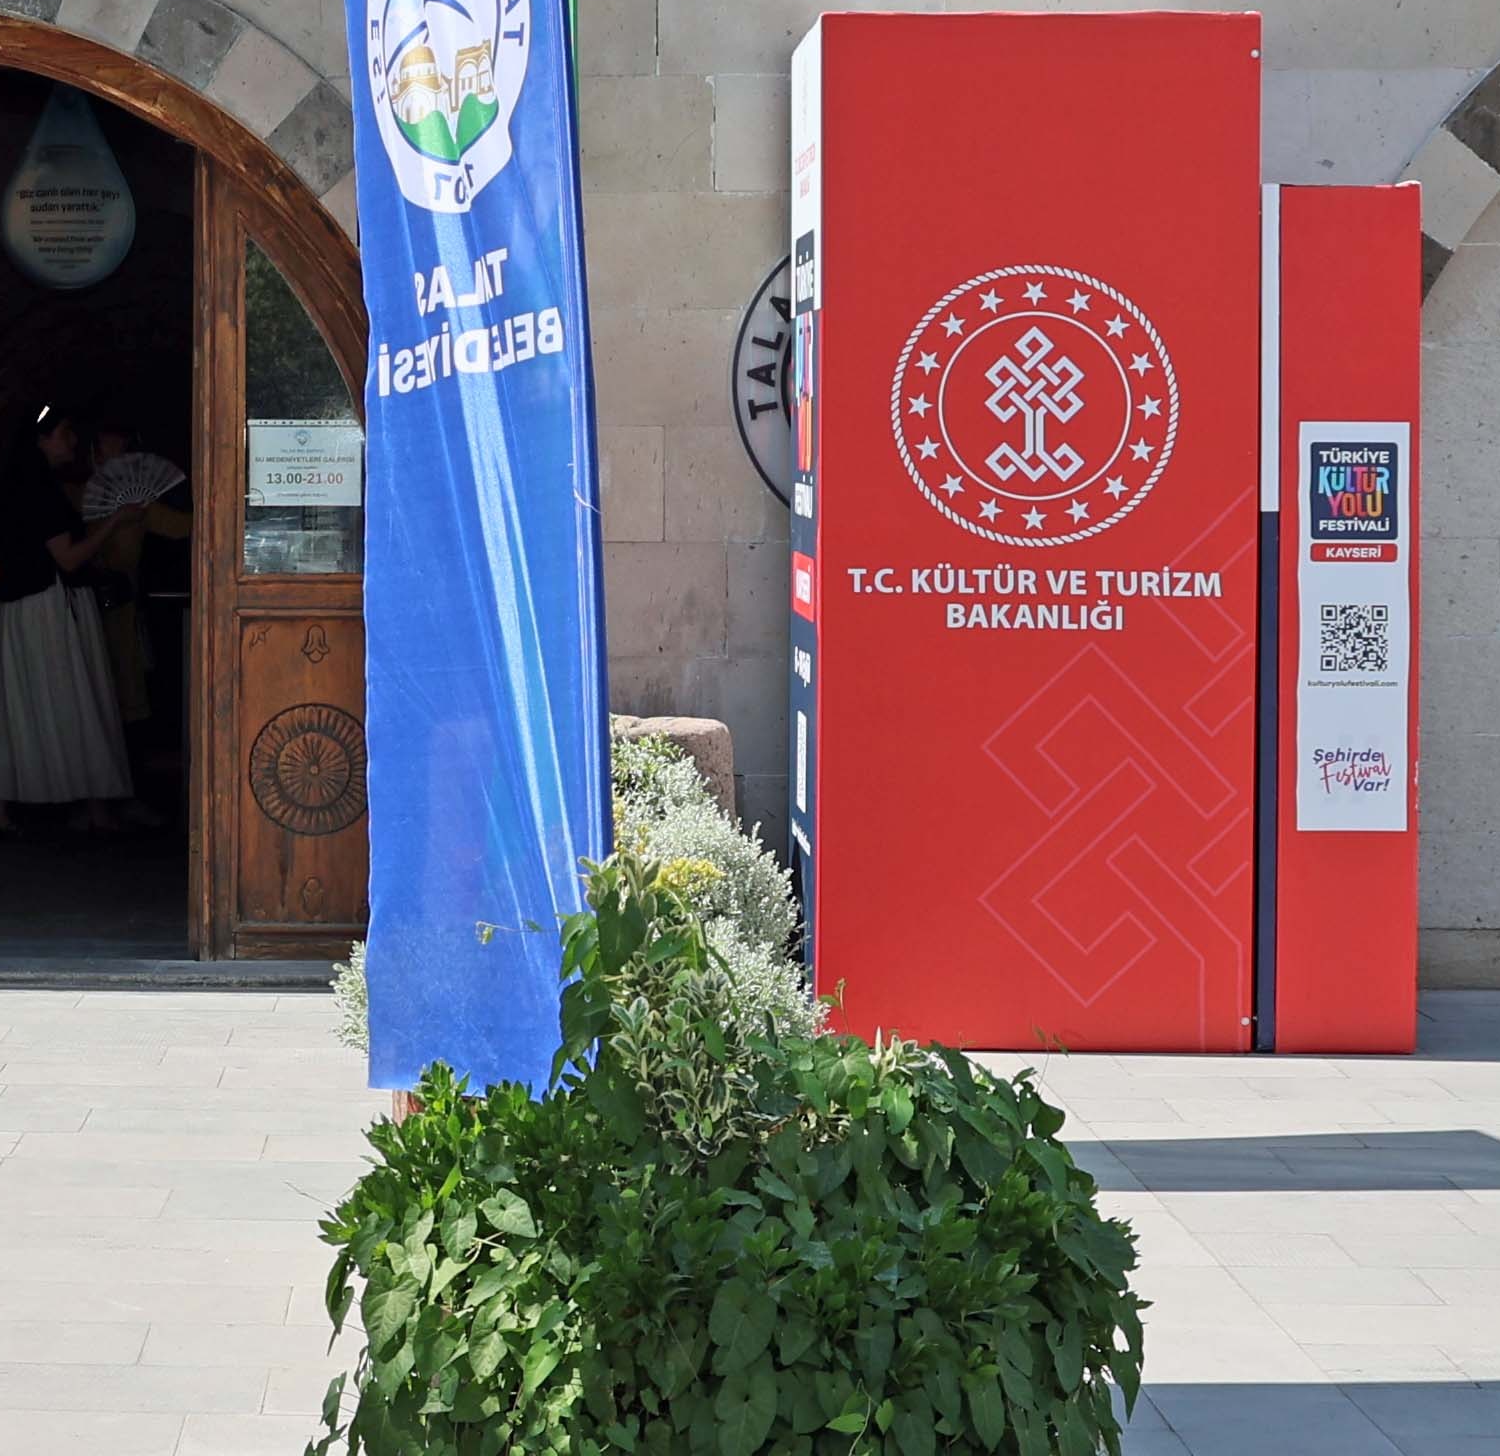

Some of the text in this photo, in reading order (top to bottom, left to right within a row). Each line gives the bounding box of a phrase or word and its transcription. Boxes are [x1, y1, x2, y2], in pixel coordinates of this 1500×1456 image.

[747, 296, 791, 420] TALA
[1319, 447, 1390, 464] TÜRKİYE
[266, 472, 344, 485] 13.00-21.00
[1318, 466, 1390, 497] KÜLTÜR
[1329, 490, 1382, 517] YOLU
[1319, 517, 1390, 532] FESTİVALİ
[1326, 544, 1382, 558] KAYSERİ
[847, 568, 903, 594] T.C.
[911, 562, 1036, 595] KÜLTÜR
[1046, 570, 1088, 595] VE
[1096, 564, 1222, 597] TURİZM
[945, 600, 1124, 631] BAKANLIĞI
[1313, 748, 1381, 764] Şehirde
[1320, 752, 1391, 794] Festival
[1354, 777, 1390, 792] Var!
